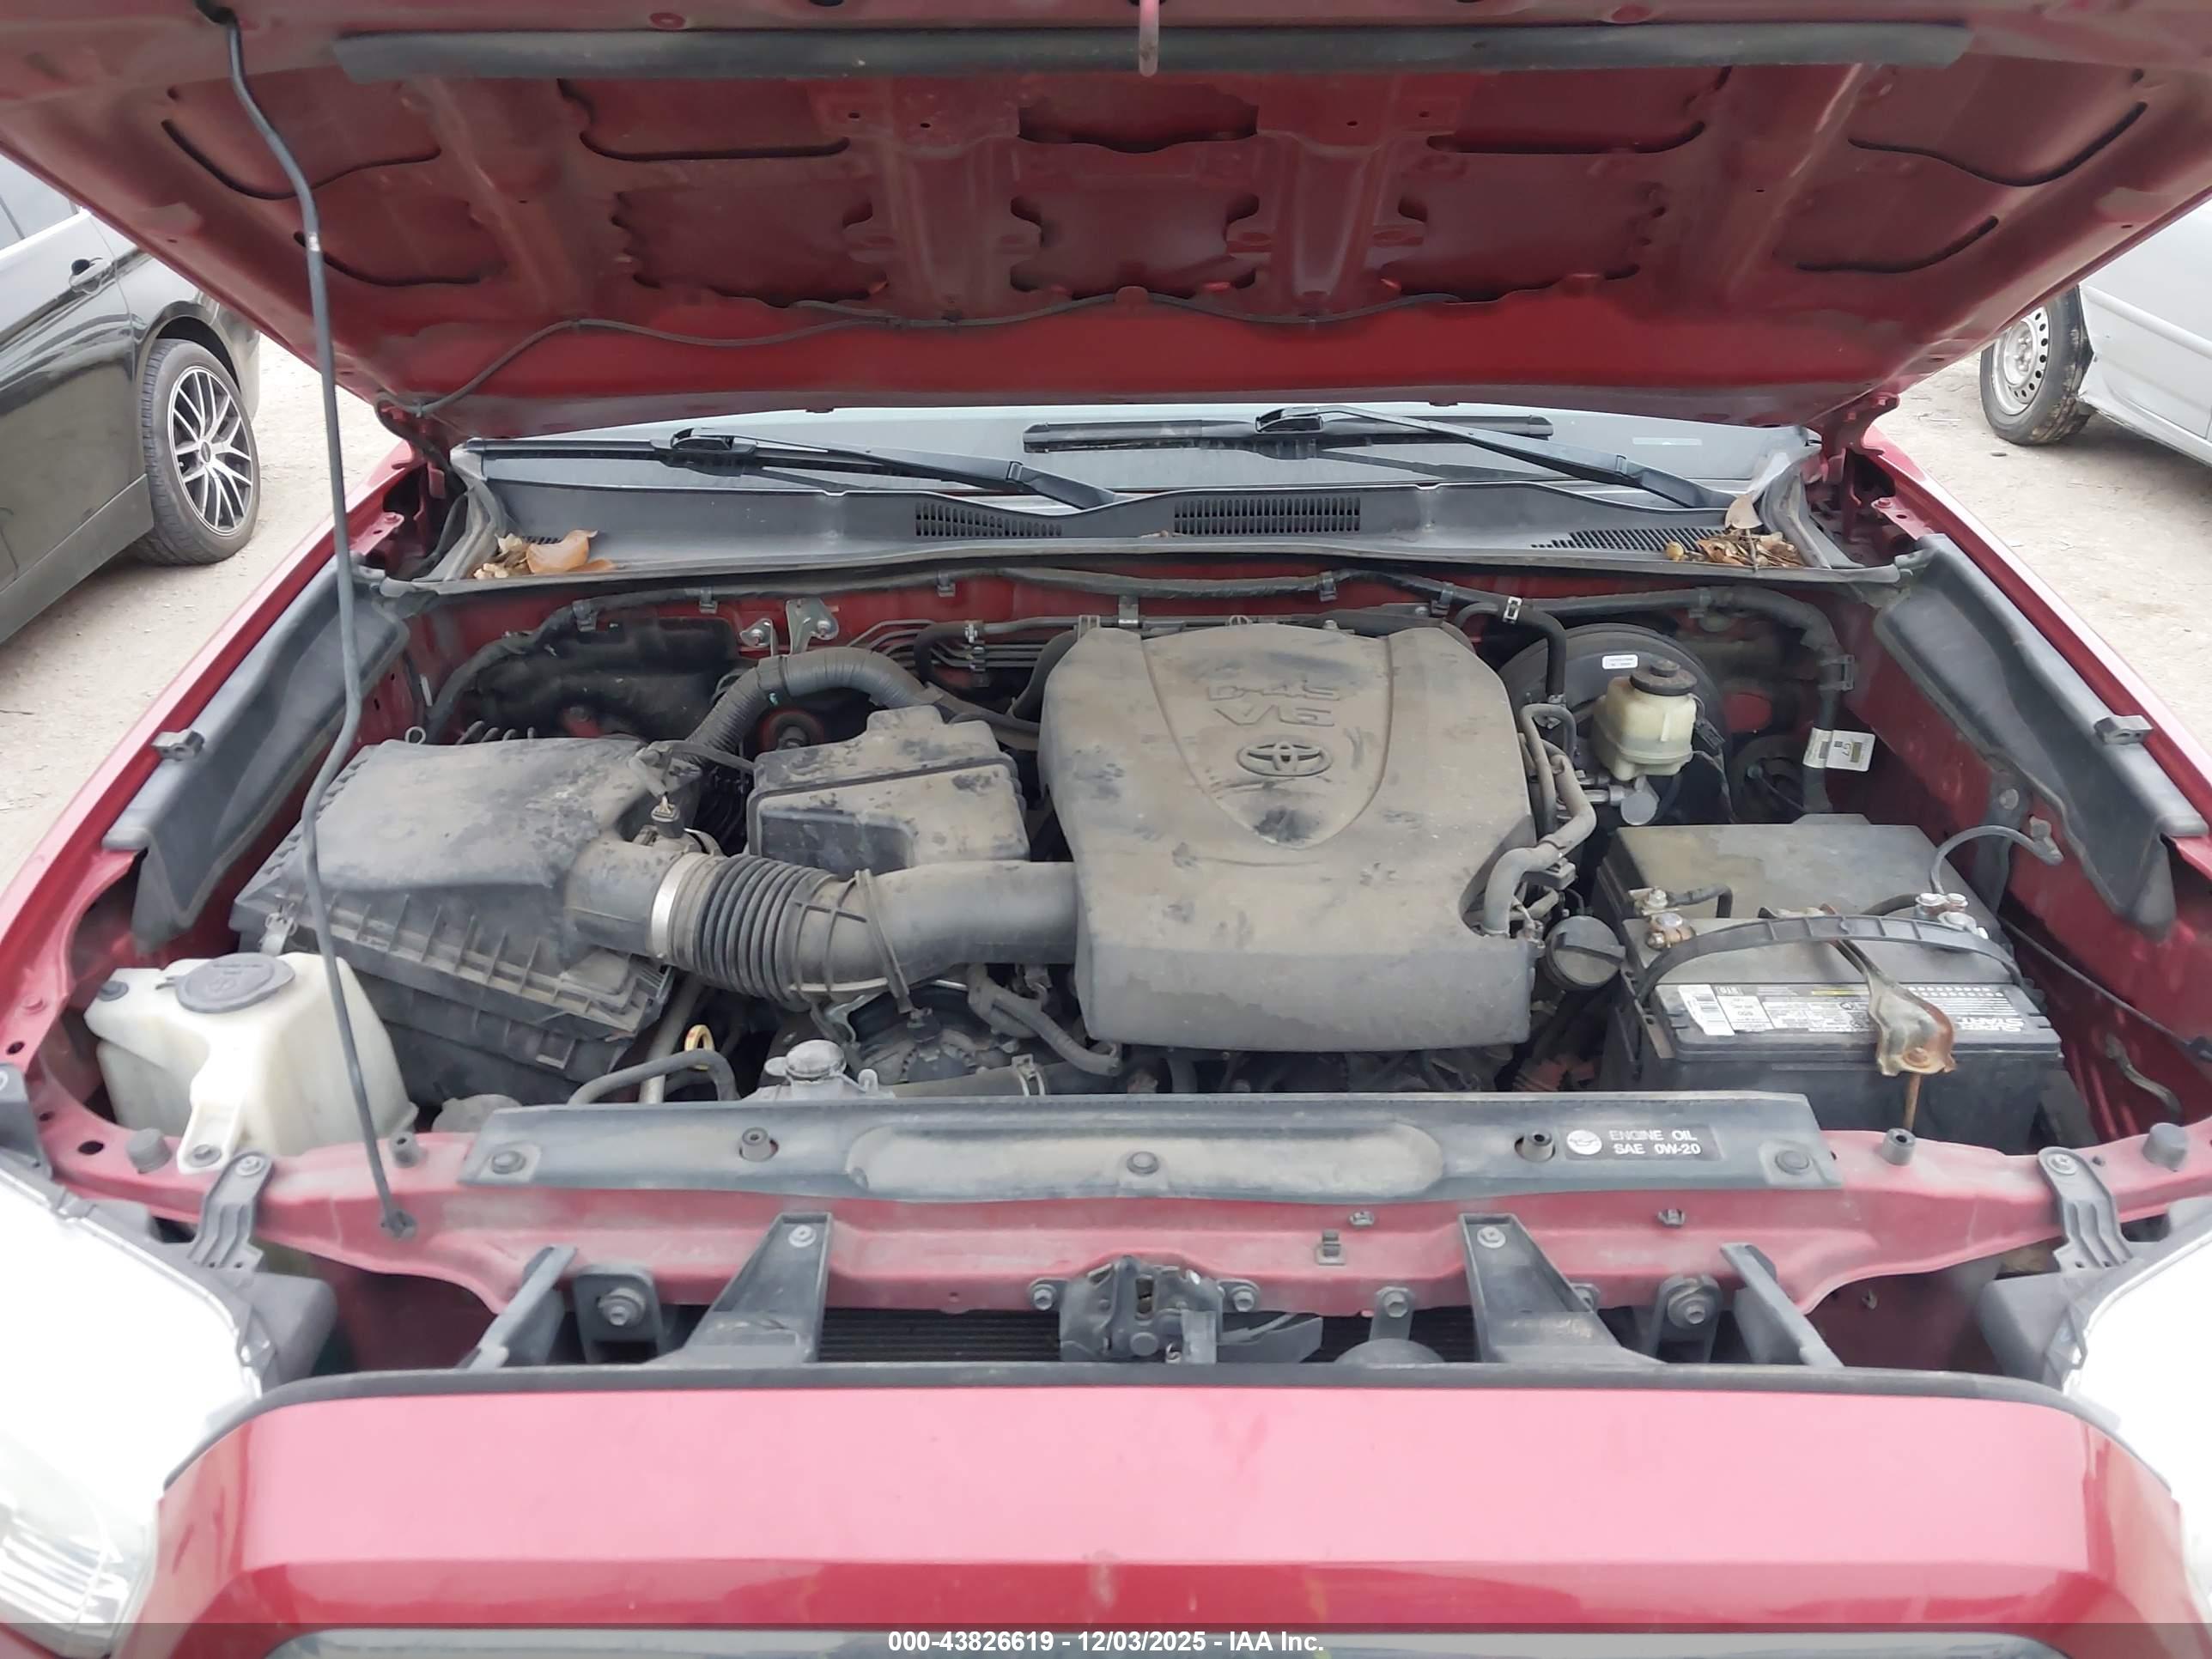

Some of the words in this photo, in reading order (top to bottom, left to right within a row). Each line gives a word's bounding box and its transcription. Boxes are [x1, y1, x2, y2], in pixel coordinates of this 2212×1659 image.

[1608, 1129, 1664, 1141] ENGINE
[1671, 1129, 1698, 1141] OIL
[1613, 1143, 1646, 1155] SAE
[1654, 1143, 1702, 1155] 0W-20
